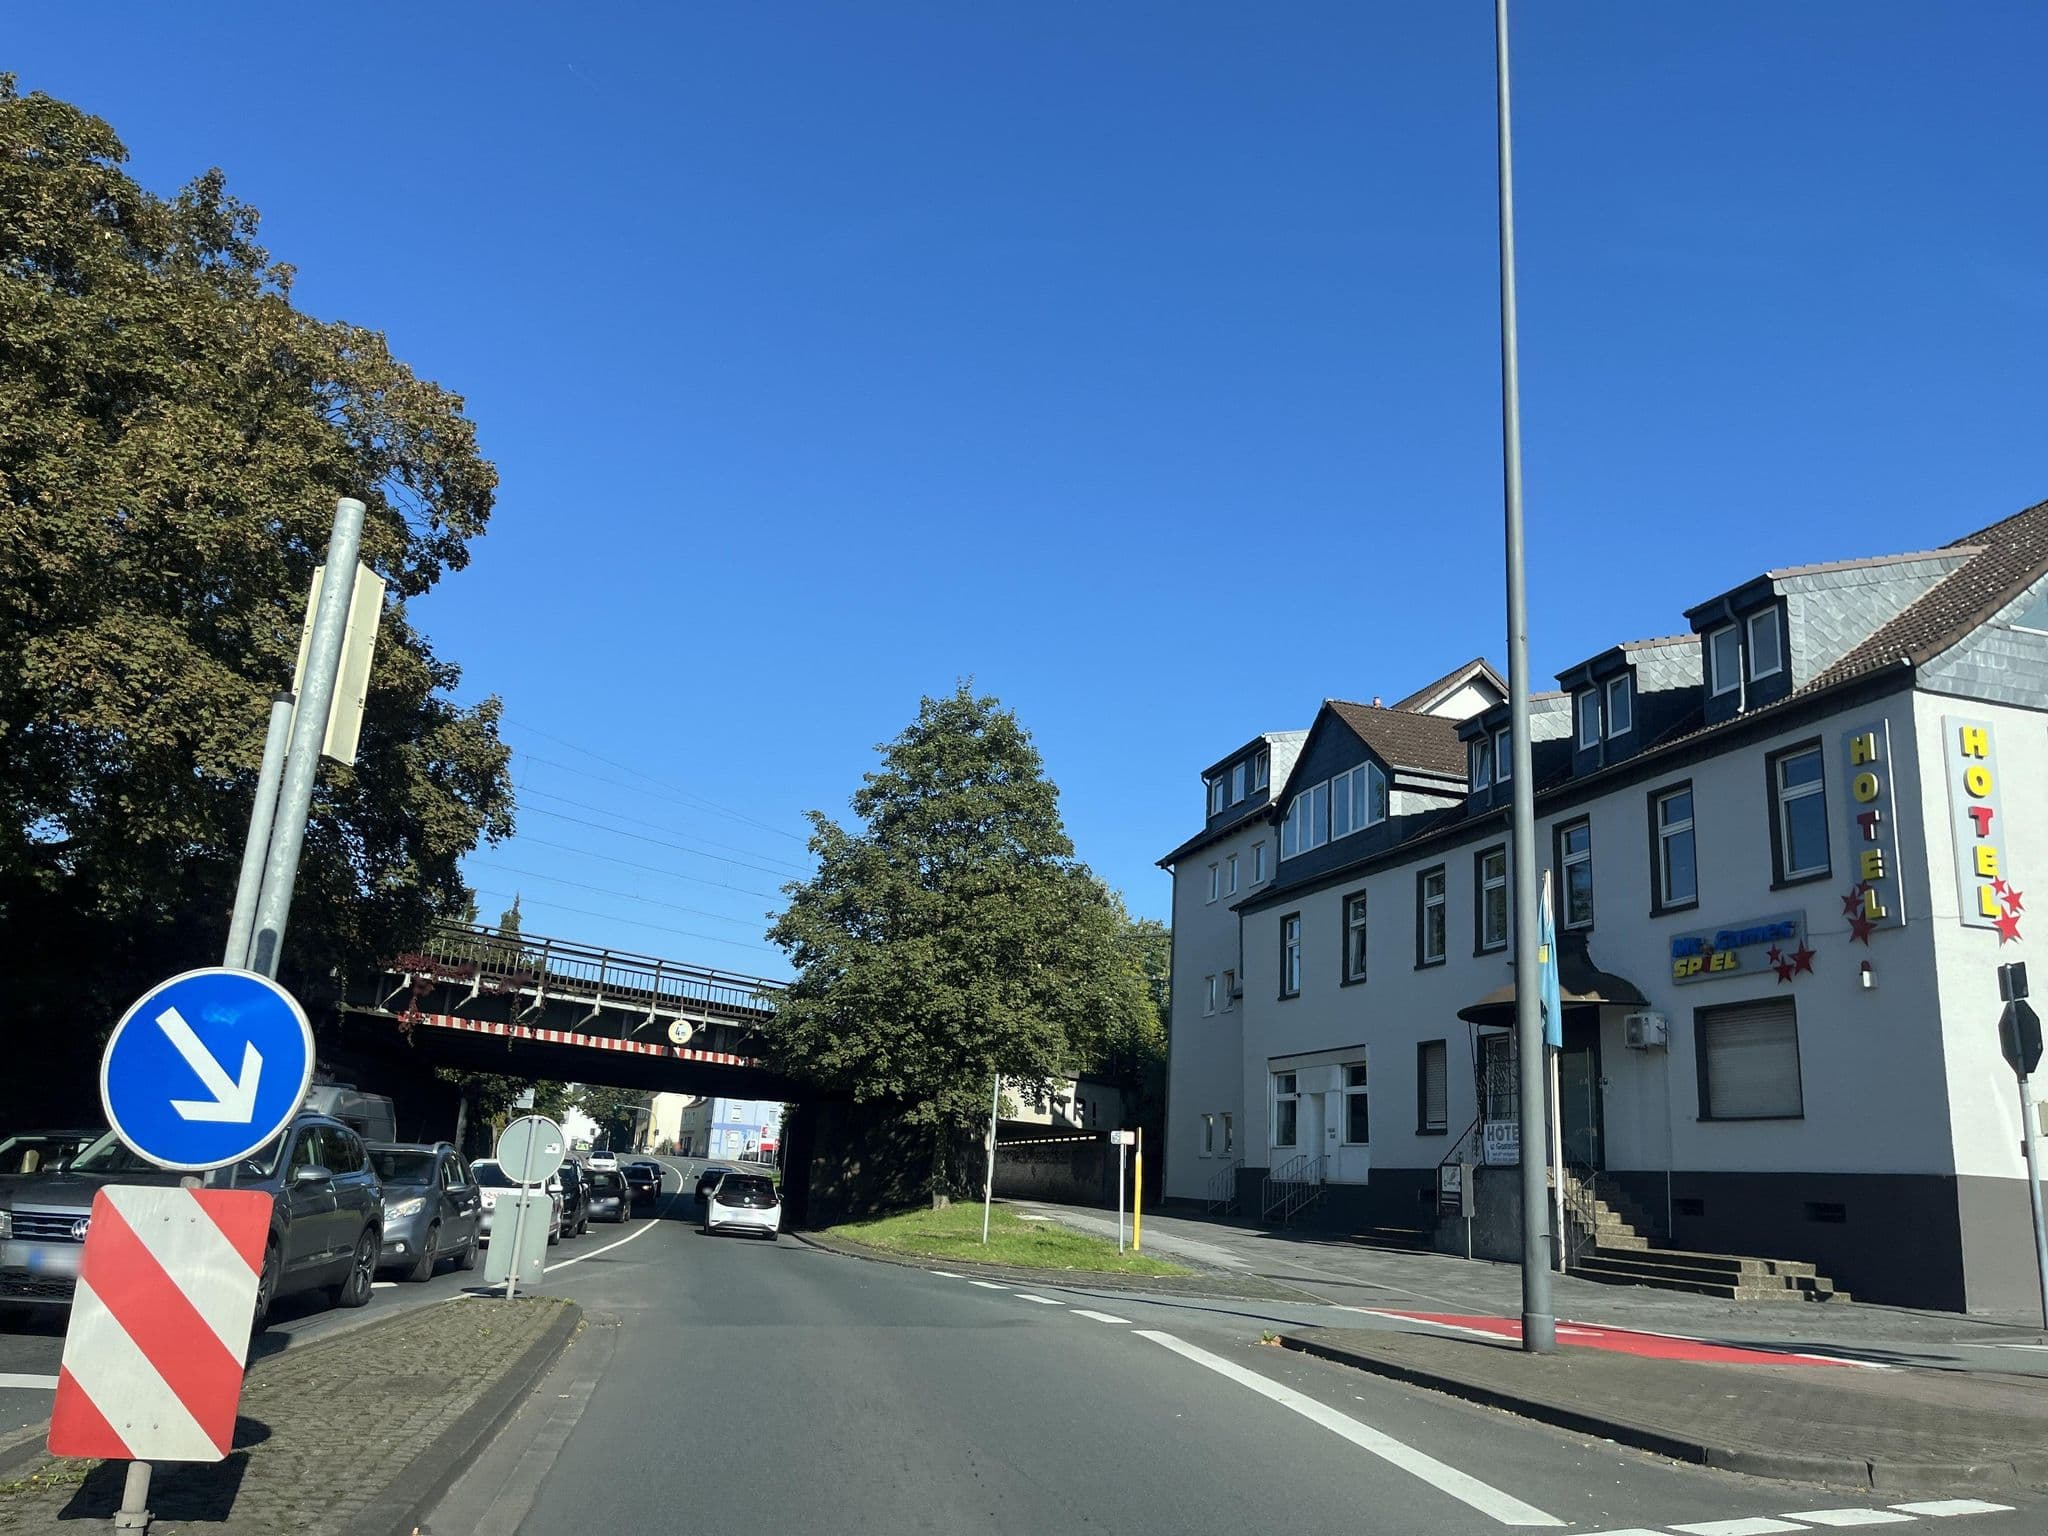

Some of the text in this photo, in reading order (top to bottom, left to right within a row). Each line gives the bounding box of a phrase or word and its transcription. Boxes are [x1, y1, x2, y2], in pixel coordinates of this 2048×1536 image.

[1850, 732, 1887, 919] HOTEL
[1960, 725, 2002, 917] HOTEL
[1487, 1124, 1519, 1142] HOTE
